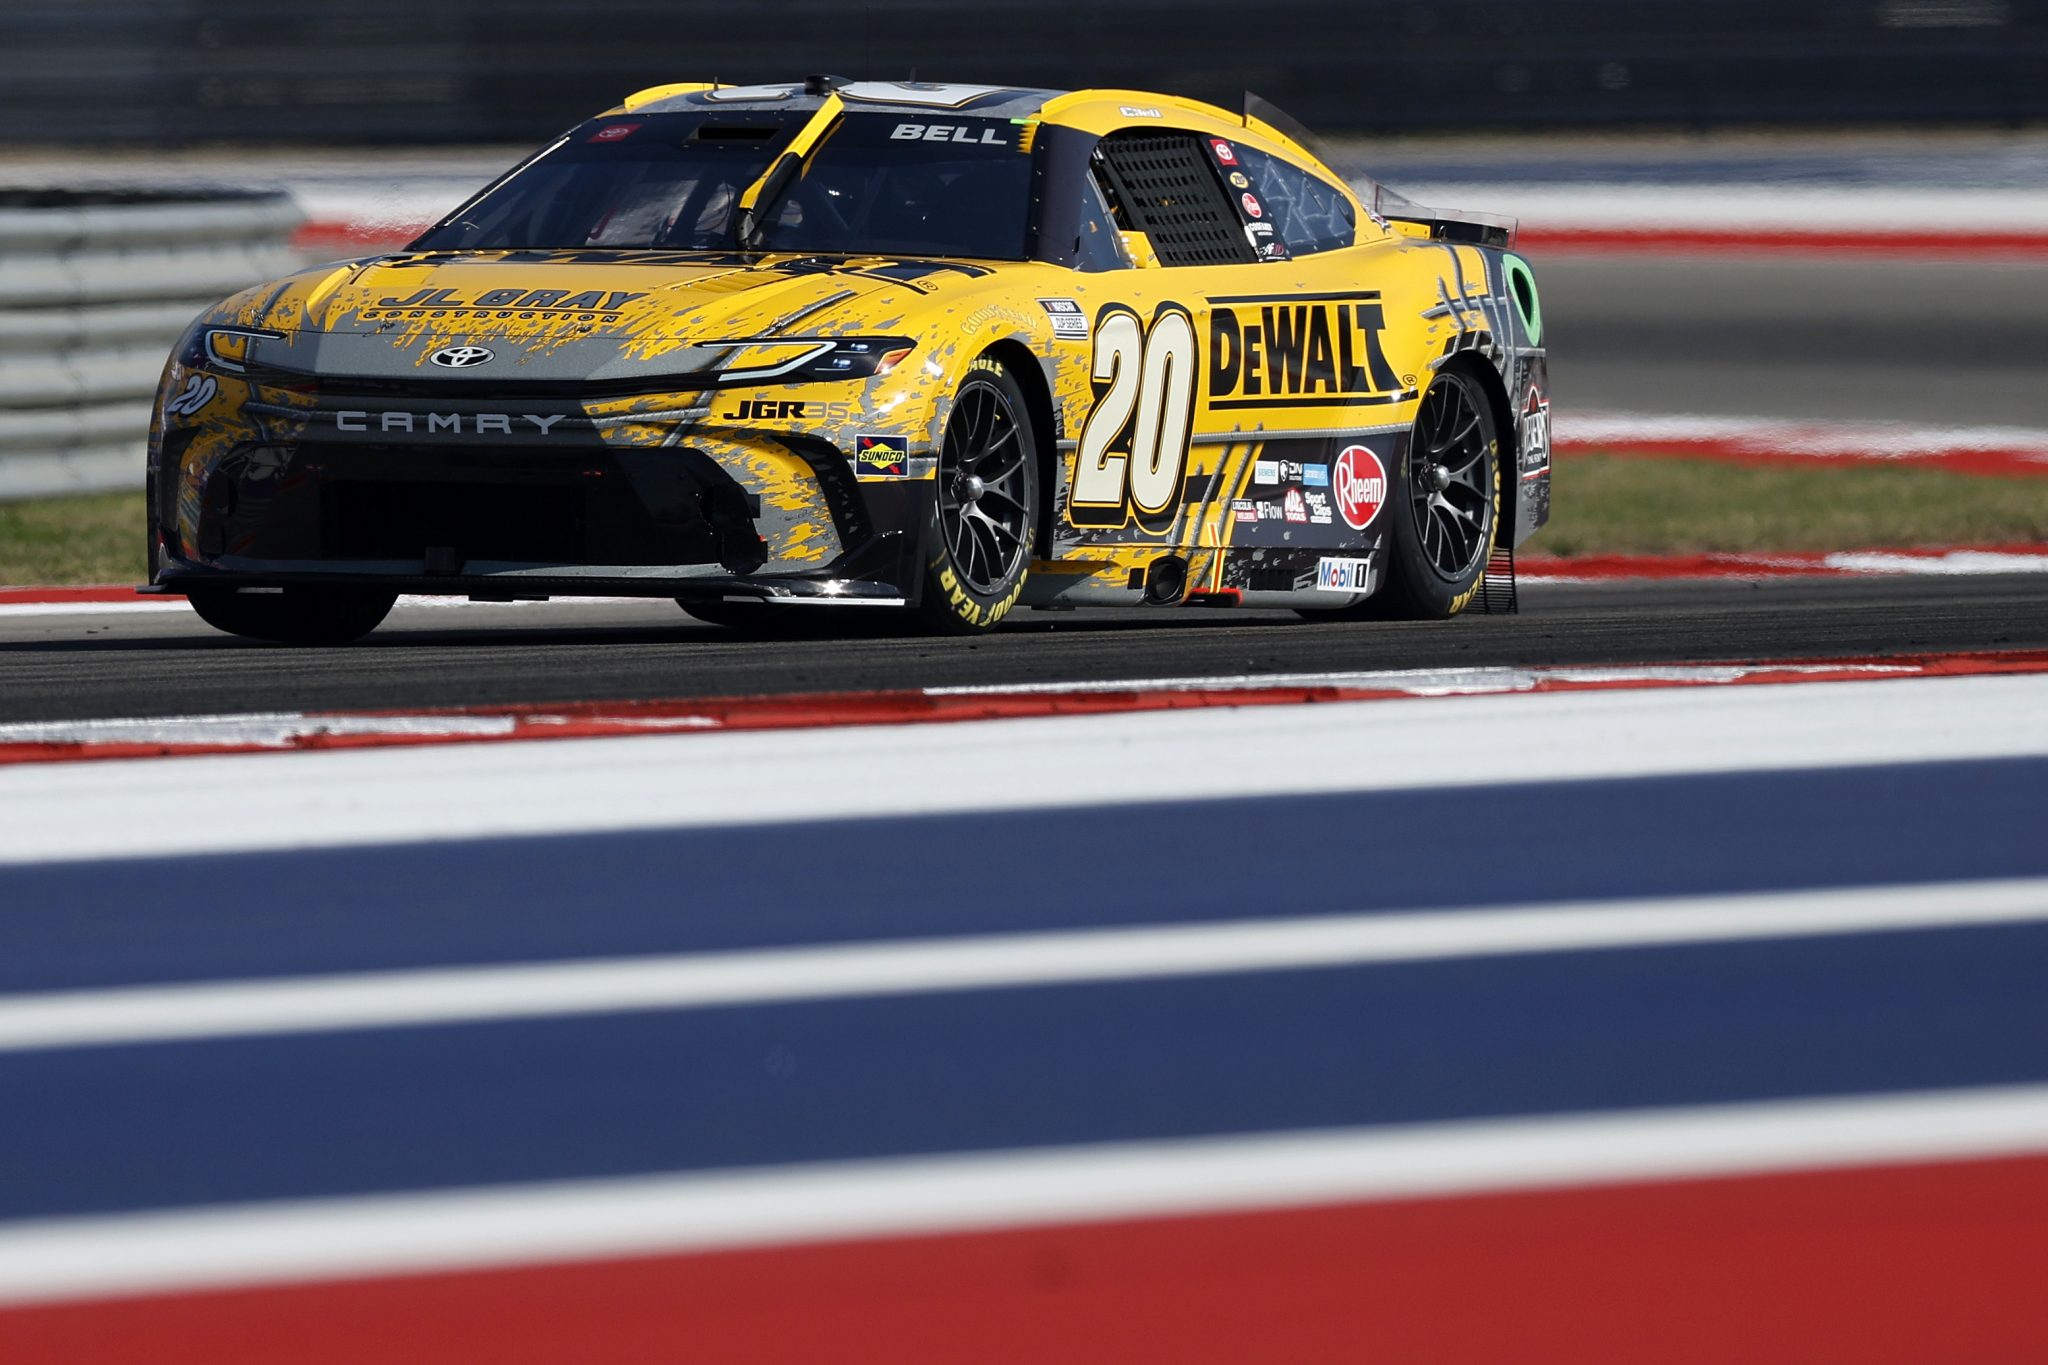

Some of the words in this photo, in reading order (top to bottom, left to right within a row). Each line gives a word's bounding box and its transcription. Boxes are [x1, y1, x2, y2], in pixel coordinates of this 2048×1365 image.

[889, 124, 1007, 145] BELL
[378, 288, 462, 307] JL
[473, 288, 650, 311] GRAY
[362, 309, 620, 323] CONSTRUCTION
[1065, 317, 1083, 329] SERIES
[165, 373, 218, 416] 20
[1071, 306, 1196, 518] 20
[336, 410, 568, 436] CAMRY
[860, 449, 904, 463] SUNOCO
[1338, 449, 1382, 515] Rheem
[1305, 491, 1327, 507] Sport
[1263, 501, 1283, 519] Flow
[1286, 512, 1307, 521] TOOLS
[1313, 504, 1332, 519] Clips
[1319, 561, 1354, 588] Mobil
